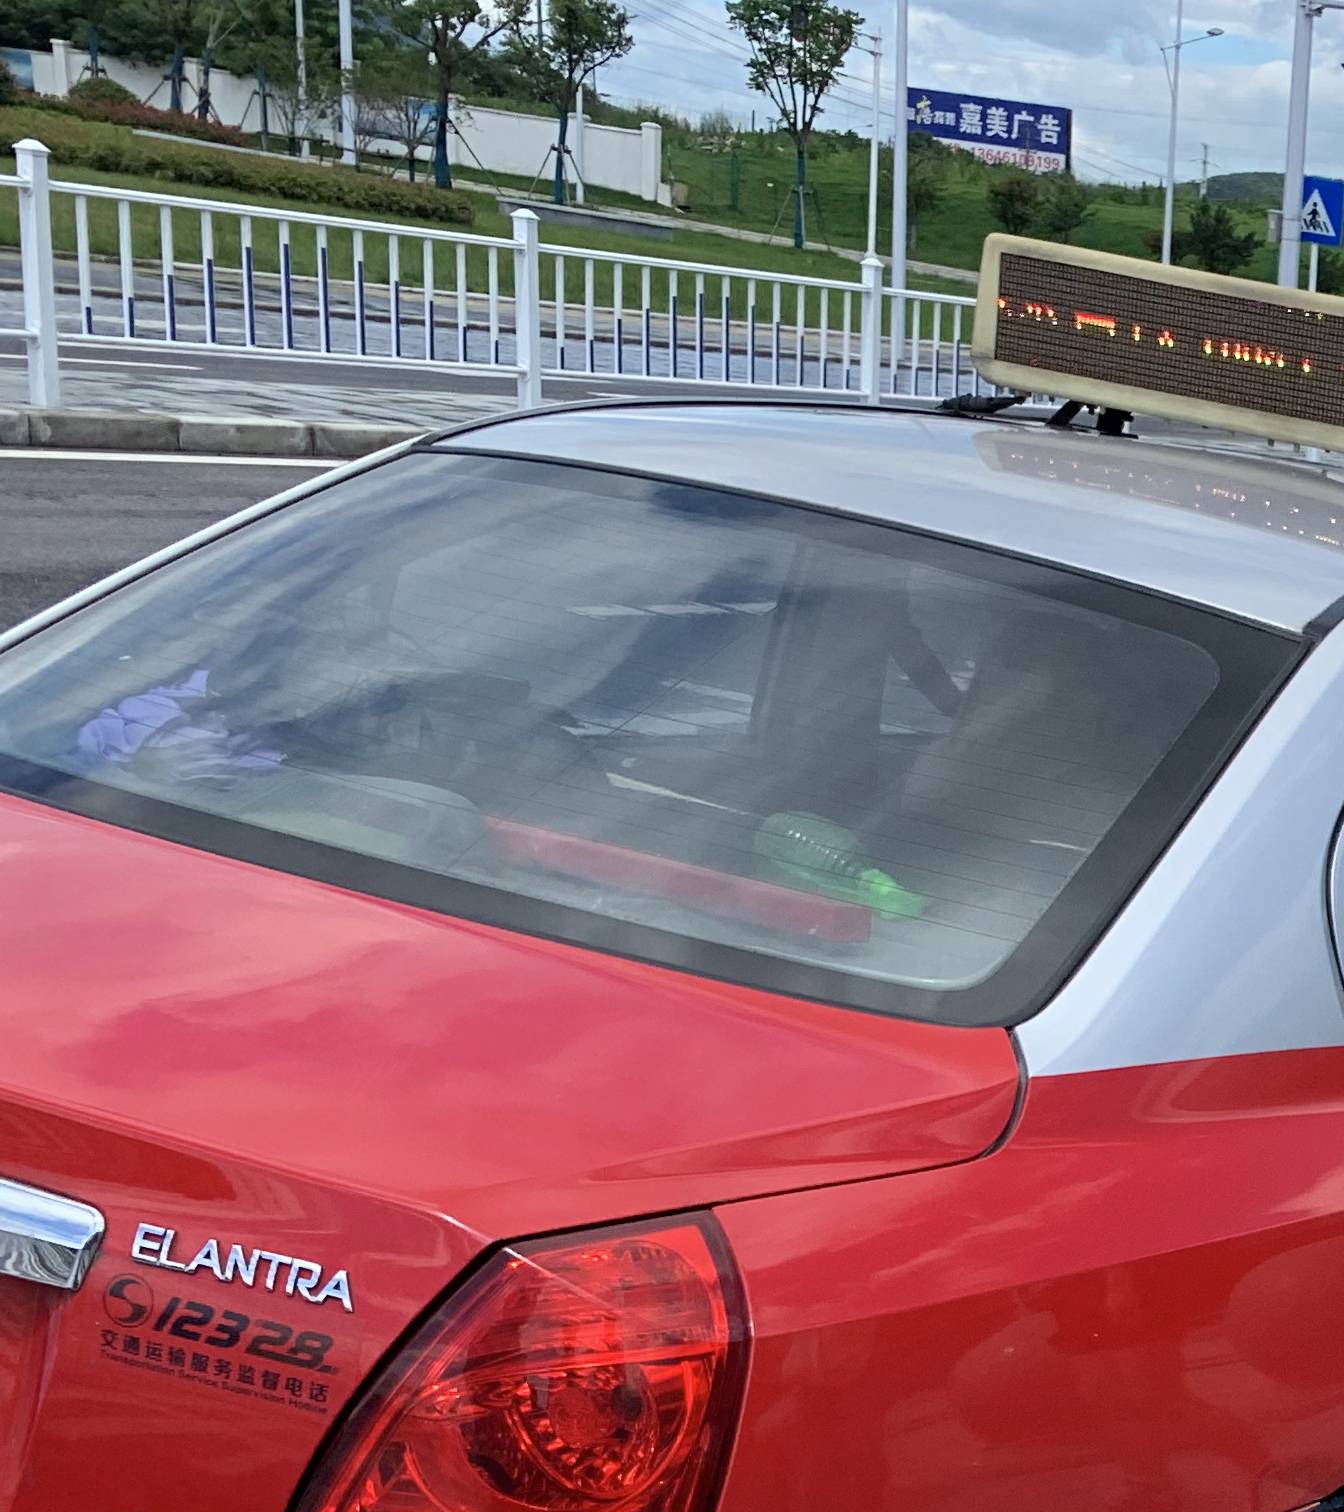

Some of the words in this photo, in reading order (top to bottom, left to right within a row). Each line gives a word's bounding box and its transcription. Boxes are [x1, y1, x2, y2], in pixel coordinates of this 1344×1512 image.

[959, 103, 1061, 144] 嘉美广告
[131, 1222, 354, 1312] ELANTRA
[100, 1329, 329, 1402] 交通运输服务监督电话
[152, 1296, 335, 1372] 12328
